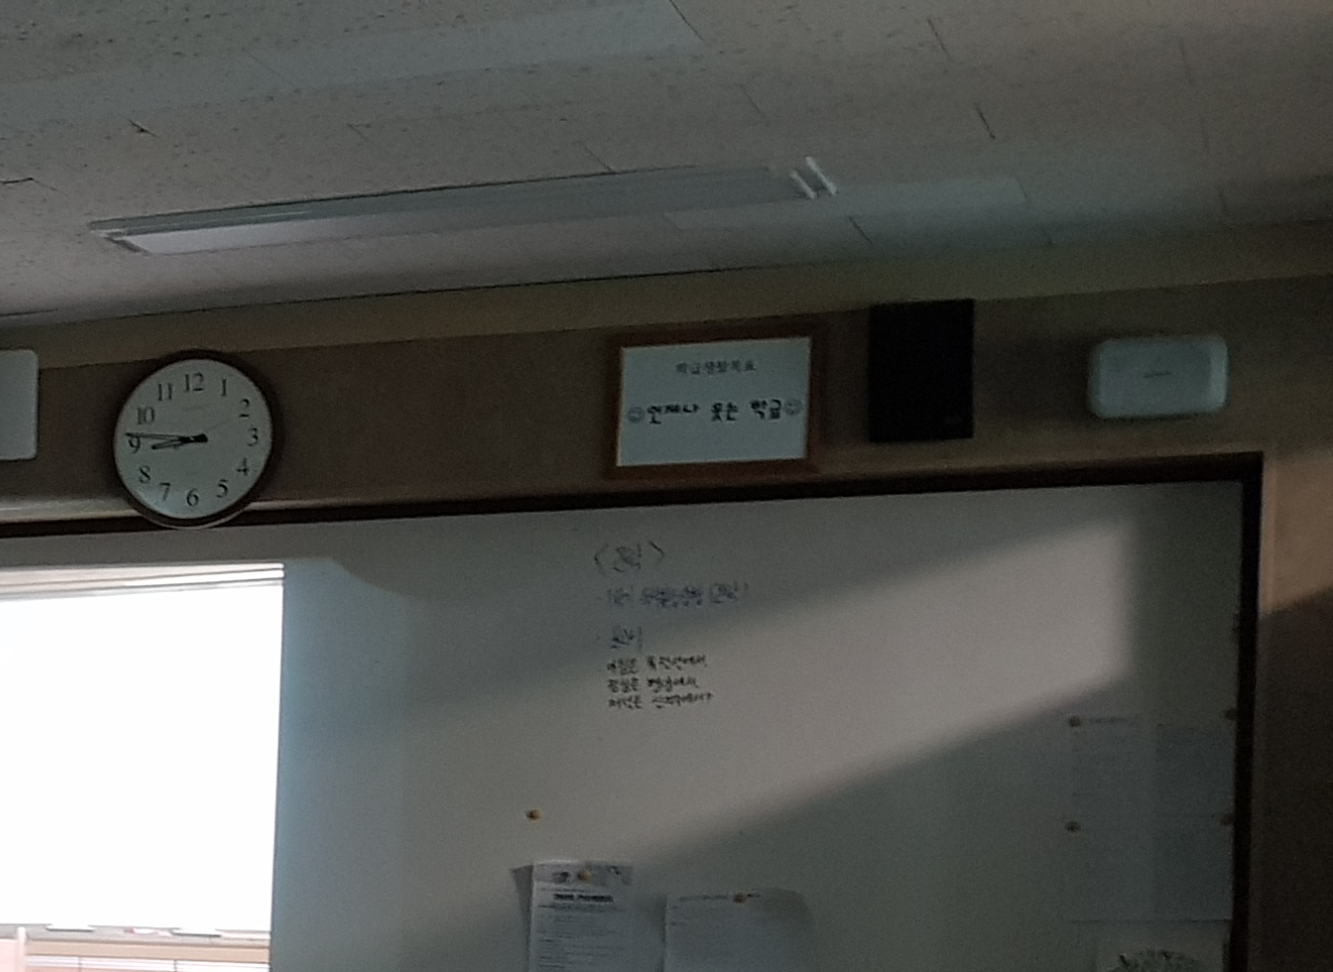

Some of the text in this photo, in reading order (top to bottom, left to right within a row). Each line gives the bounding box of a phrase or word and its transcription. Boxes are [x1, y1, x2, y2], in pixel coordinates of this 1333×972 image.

[157, 382, 174, 401] 11
[183, 371, 205, 393] 12
[221, 378, 227, 397] 1
[136, 406, 155, 425] 10
[238, 398, 250, 418] 2
[647, 398, 781, 424] 언제나 웃는 학급
[128, 435, 141, 454] 9
[247, 427, 258, 447] 3
[138, 465, 151, 484] 8
[235, 458, 250, 477] 4
[159, 482, 171, 501] 7
[186, 487, 199, 507] 6
[216, 479, 229, 498] 5
